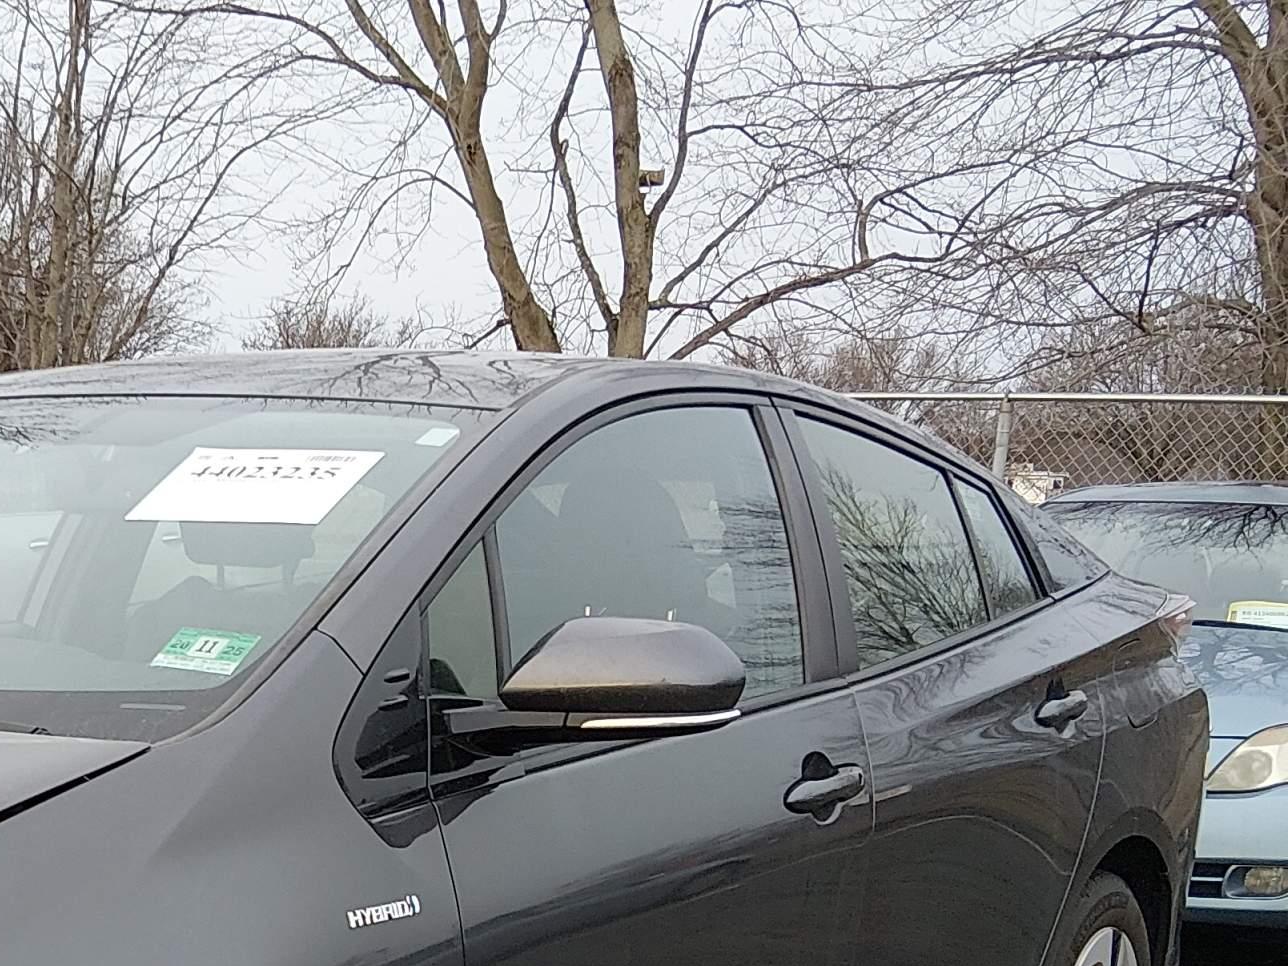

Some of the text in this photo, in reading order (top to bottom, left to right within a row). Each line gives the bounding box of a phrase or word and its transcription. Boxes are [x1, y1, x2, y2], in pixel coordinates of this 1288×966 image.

[191, 466, 341, 479] 44023235
[170, 639, 245, 657] 20 11 25
[347, 900, 413, 928] HYBRID
